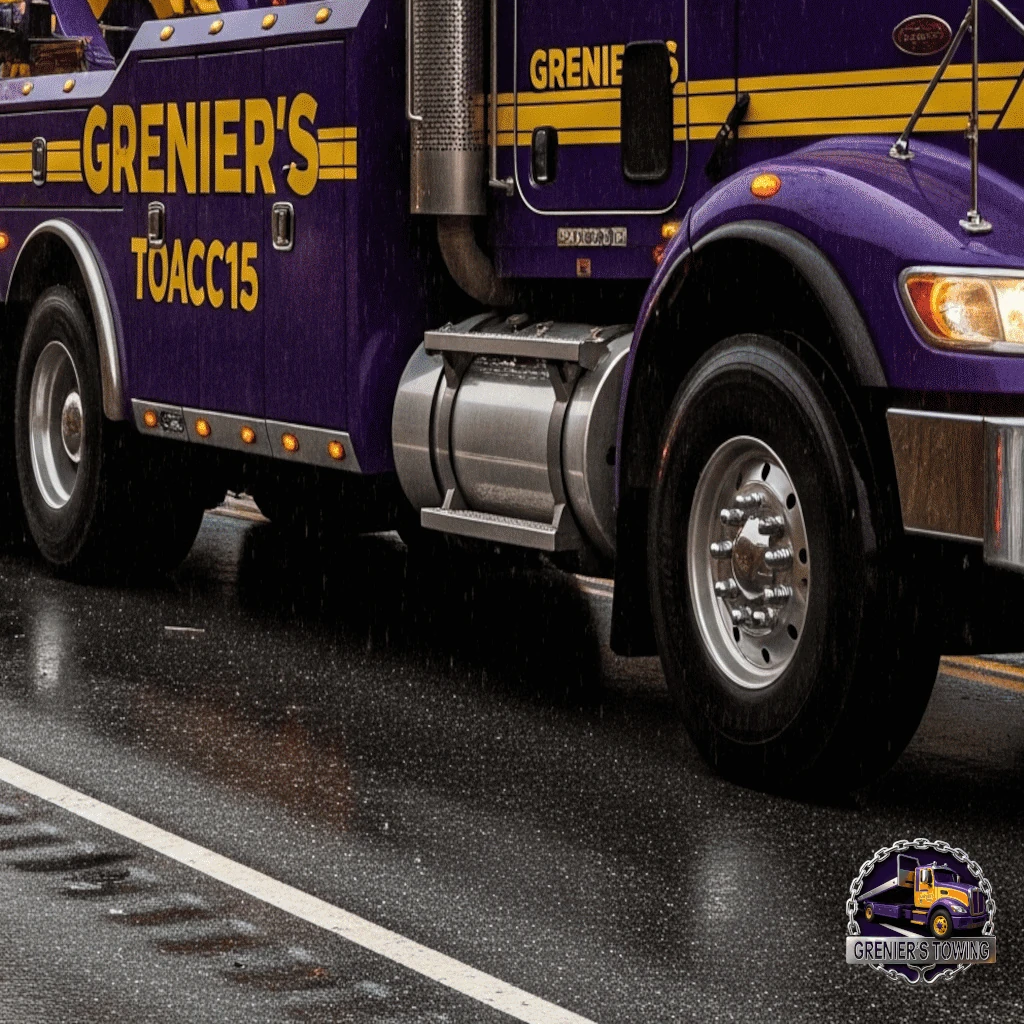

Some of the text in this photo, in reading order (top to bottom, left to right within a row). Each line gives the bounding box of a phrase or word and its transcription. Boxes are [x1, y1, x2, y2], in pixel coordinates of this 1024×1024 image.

[529, 40, 679, 90] GRENIE
[83, 92, 320, 196] GRENIER'S
[131, 236, 259, 312] TOACC15
